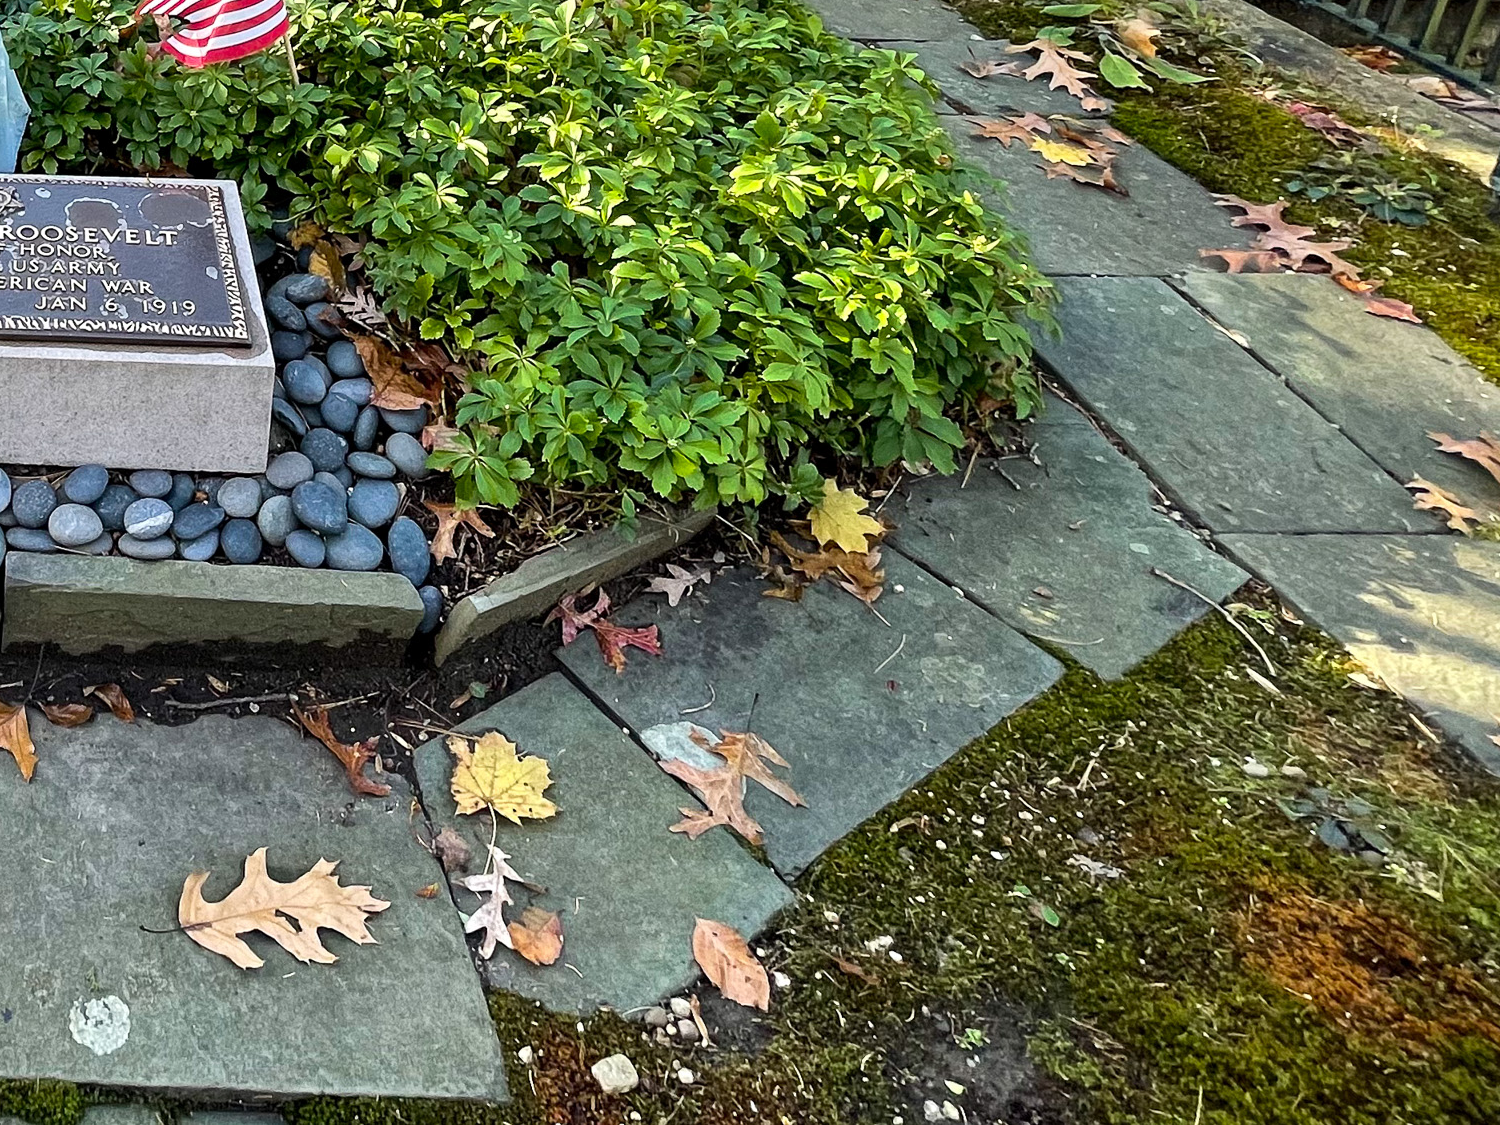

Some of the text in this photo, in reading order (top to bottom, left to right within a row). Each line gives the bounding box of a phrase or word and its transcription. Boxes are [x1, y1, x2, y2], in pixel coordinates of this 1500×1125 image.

[19, 243, 107, 260] HONOR
[13, 259, 39, 273] US
[50, 261, 121, 275] ARMY
[101, 279, 155, 295] WAR
[34, 296, 87, 311] JAN
[104, 297, 118, 312] 6
[142, 300, 196, 316] 1919
